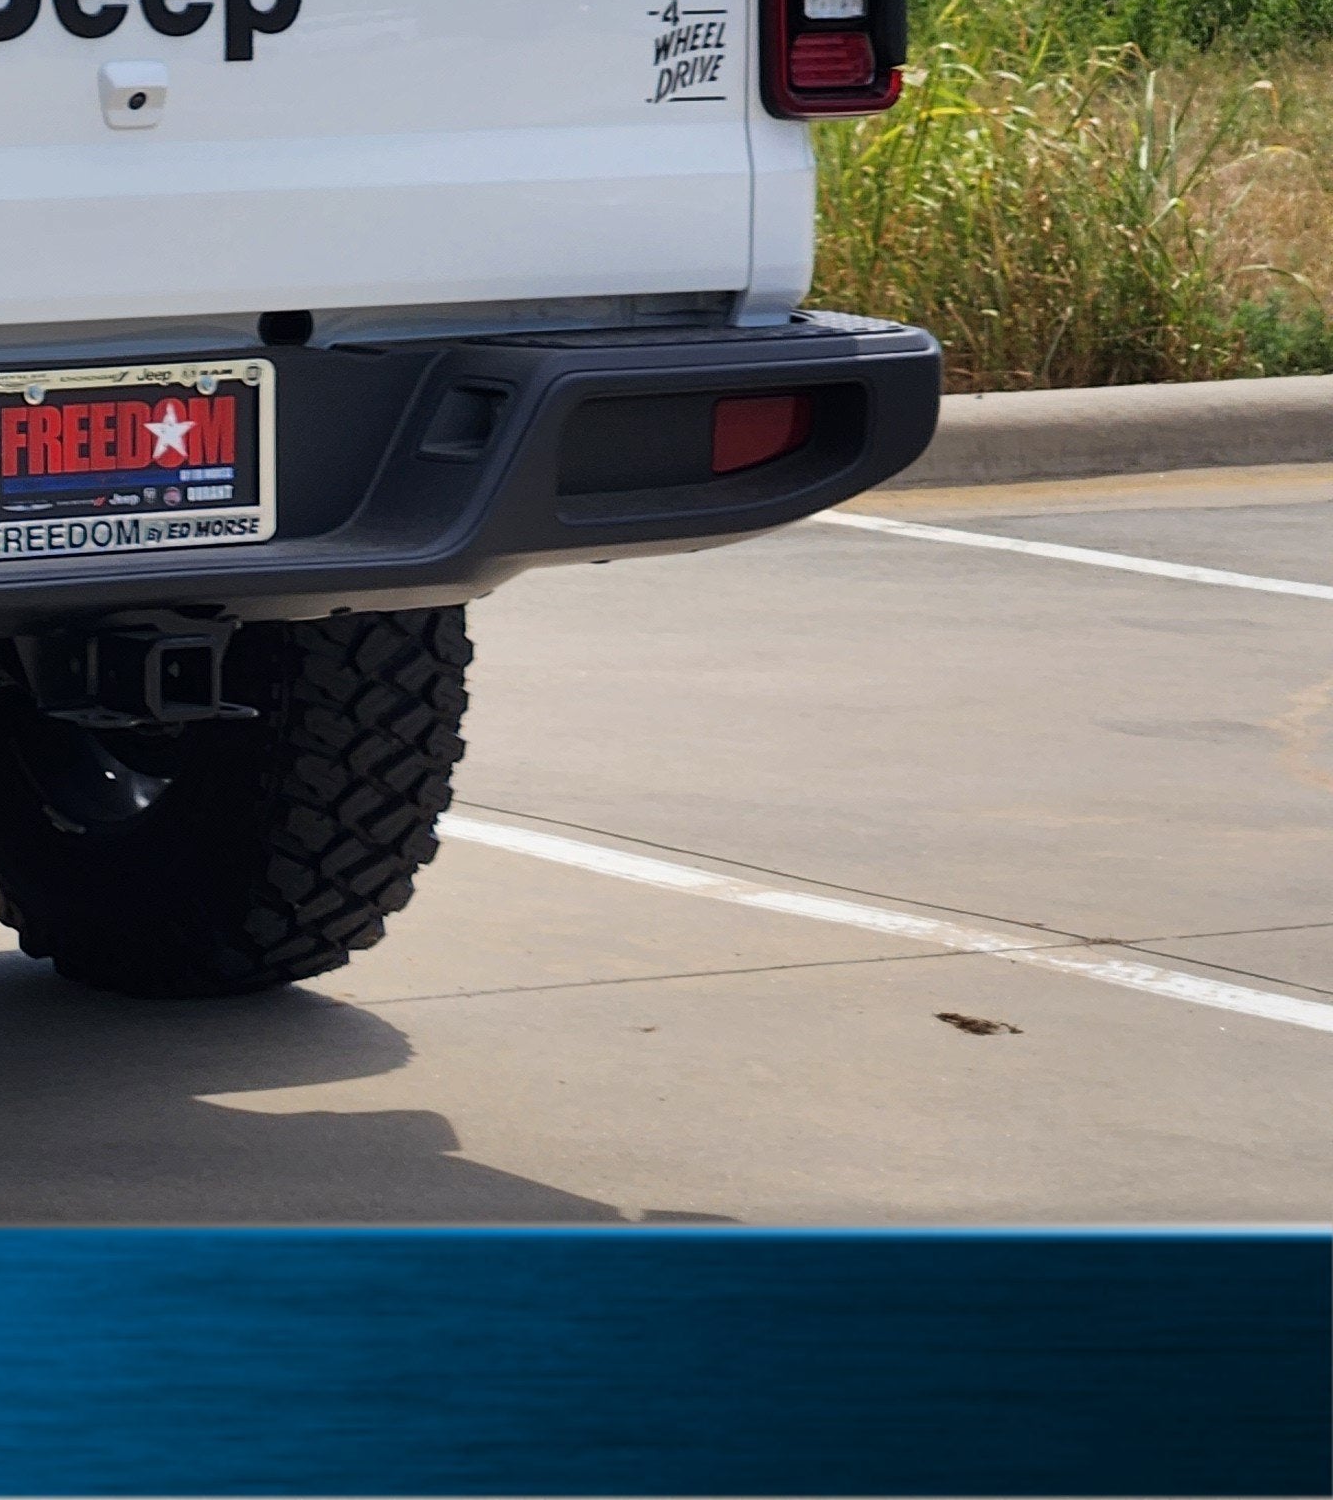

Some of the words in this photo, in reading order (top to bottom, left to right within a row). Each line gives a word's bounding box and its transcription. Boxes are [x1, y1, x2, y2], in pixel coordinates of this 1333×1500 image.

[661, 0, 681, 26] 4
[653, 22, 727, 66] WHEEL
[655, 54, 725, 102] DRIVE
[0, 396, 236, 477] FREEDOM
[167, 521, 191, 539] ED
